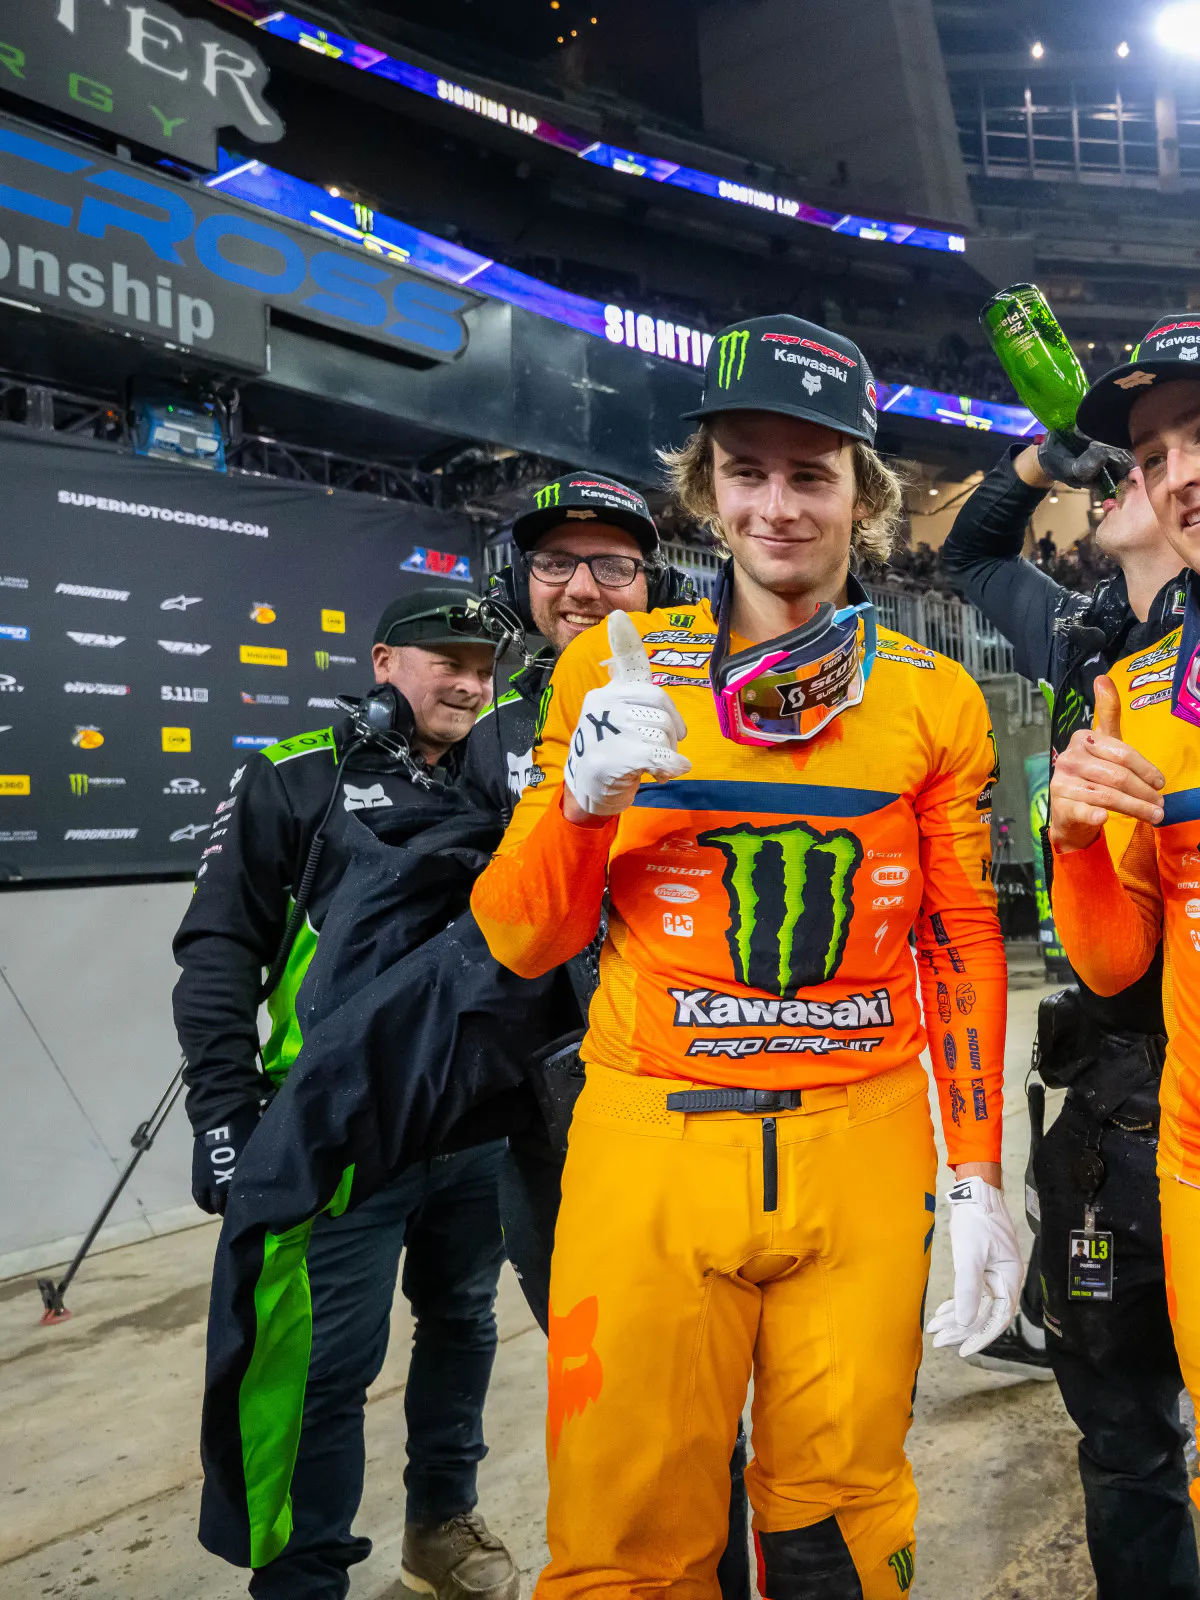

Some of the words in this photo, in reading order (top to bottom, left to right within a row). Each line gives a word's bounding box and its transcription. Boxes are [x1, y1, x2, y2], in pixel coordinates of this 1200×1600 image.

[436, 79, 508, 124] SIGHTING
[510, 109, 538, 134] LAP
[604, 303, 714, 366] SIGHTI
[1146, 322, 1178, 342] PRO
[761, 333, 801, 345] PRO
[800, 339, 857, 367] CIRCUIT
[774, 348, 848, 383] Kawasaki
[581, 489, 638, 511] Kawasaki
[57, 490, 269, 538] SUPERMOTOCROSS.COM
[55, 583, 131, 601] PROGRESSIVE
[280, 732, 331, 752] FOX
[64, 828, 139, 840] PROGRESSIVE
[645, 864, 713, 876] DUNLOP
[878, 872, 905, 880] BELL
[665, 916, 691, 932] PPG
[671, 990, 892, 1026] Kawasaki
[688, 1038, 763, 1057] PRO
[766, 1037, 881, 1054] CIRCUIT
[967, 1028, 980, 1070] SHOWA
[206, 1126, 236, 1185] FOX
[1091, 1240, 1109, 1259] L3
